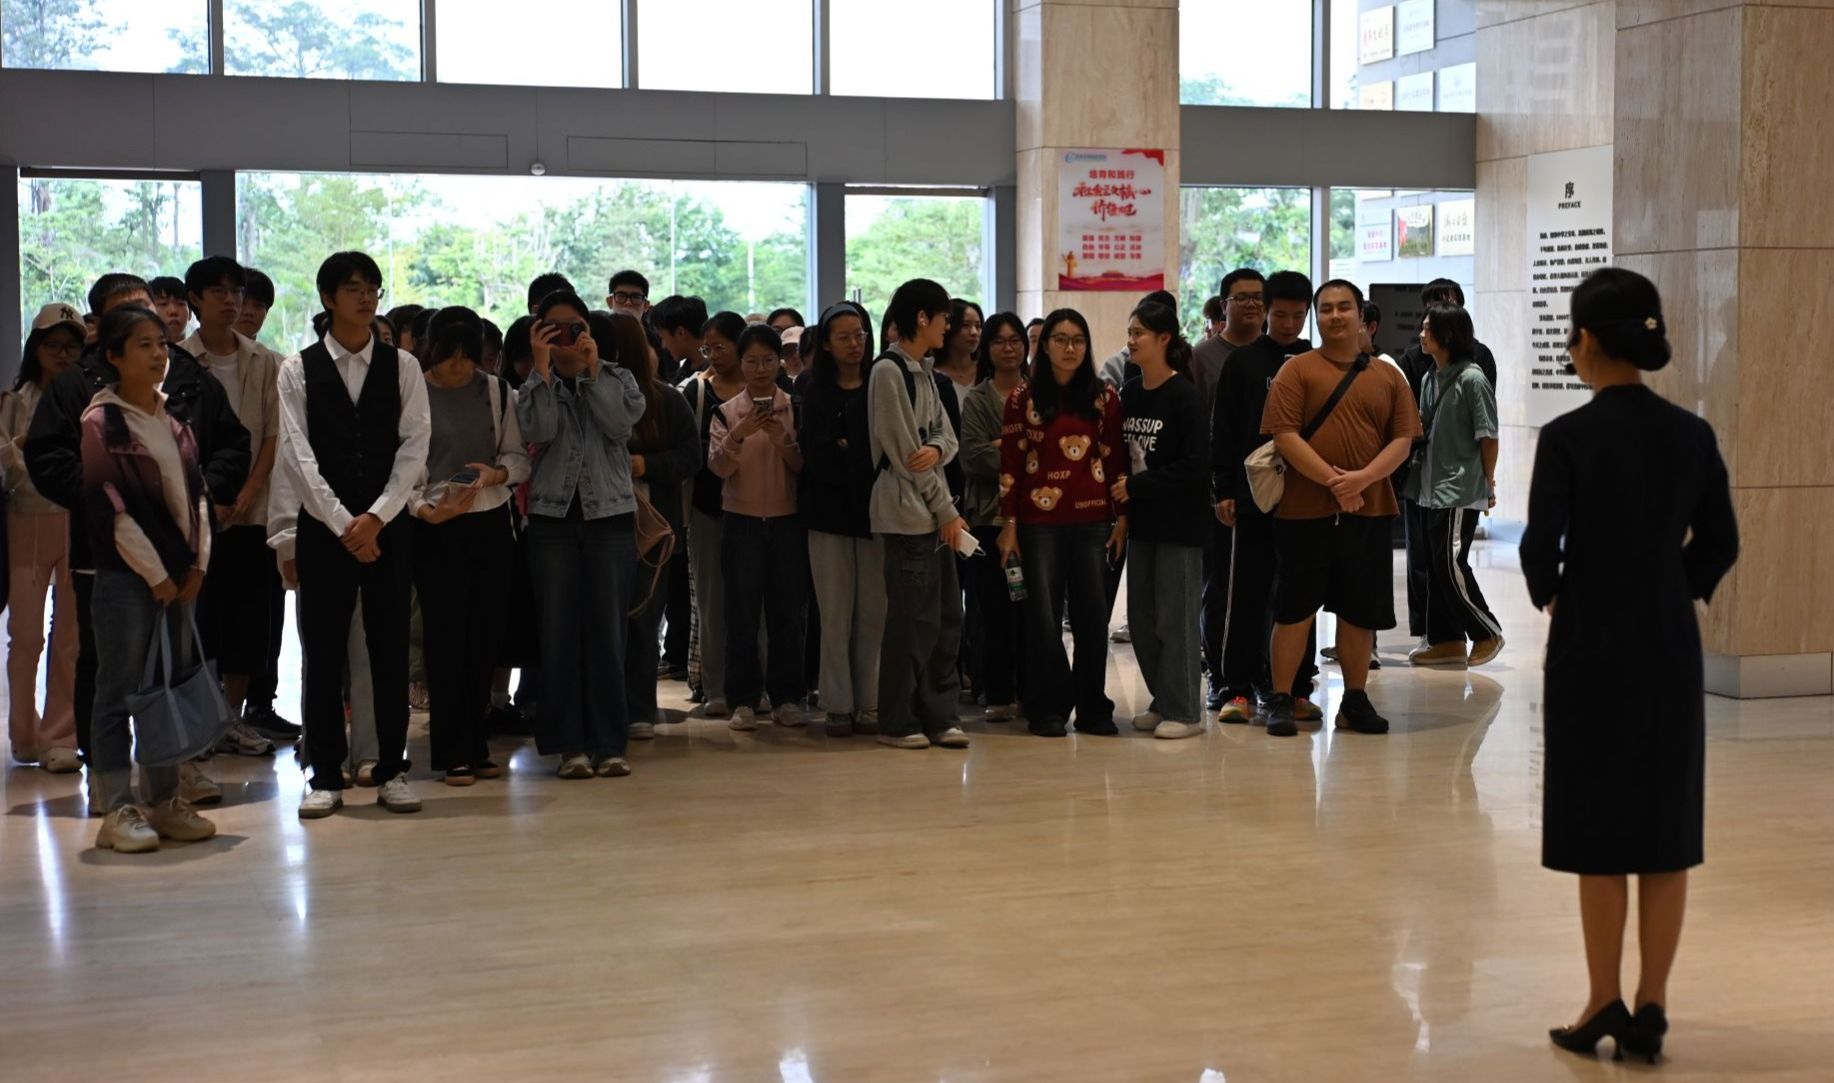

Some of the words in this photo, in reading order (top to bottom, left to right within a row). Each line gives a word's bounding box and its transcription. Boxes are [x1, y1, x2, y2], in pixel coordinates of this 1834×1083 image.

[1565, 181, 1575, 199] 序
[1558, 200, 1582, 210] PREFACE
[60, 306, 74, 320] NY
[1047, 470, 1072, 481] HOXP
